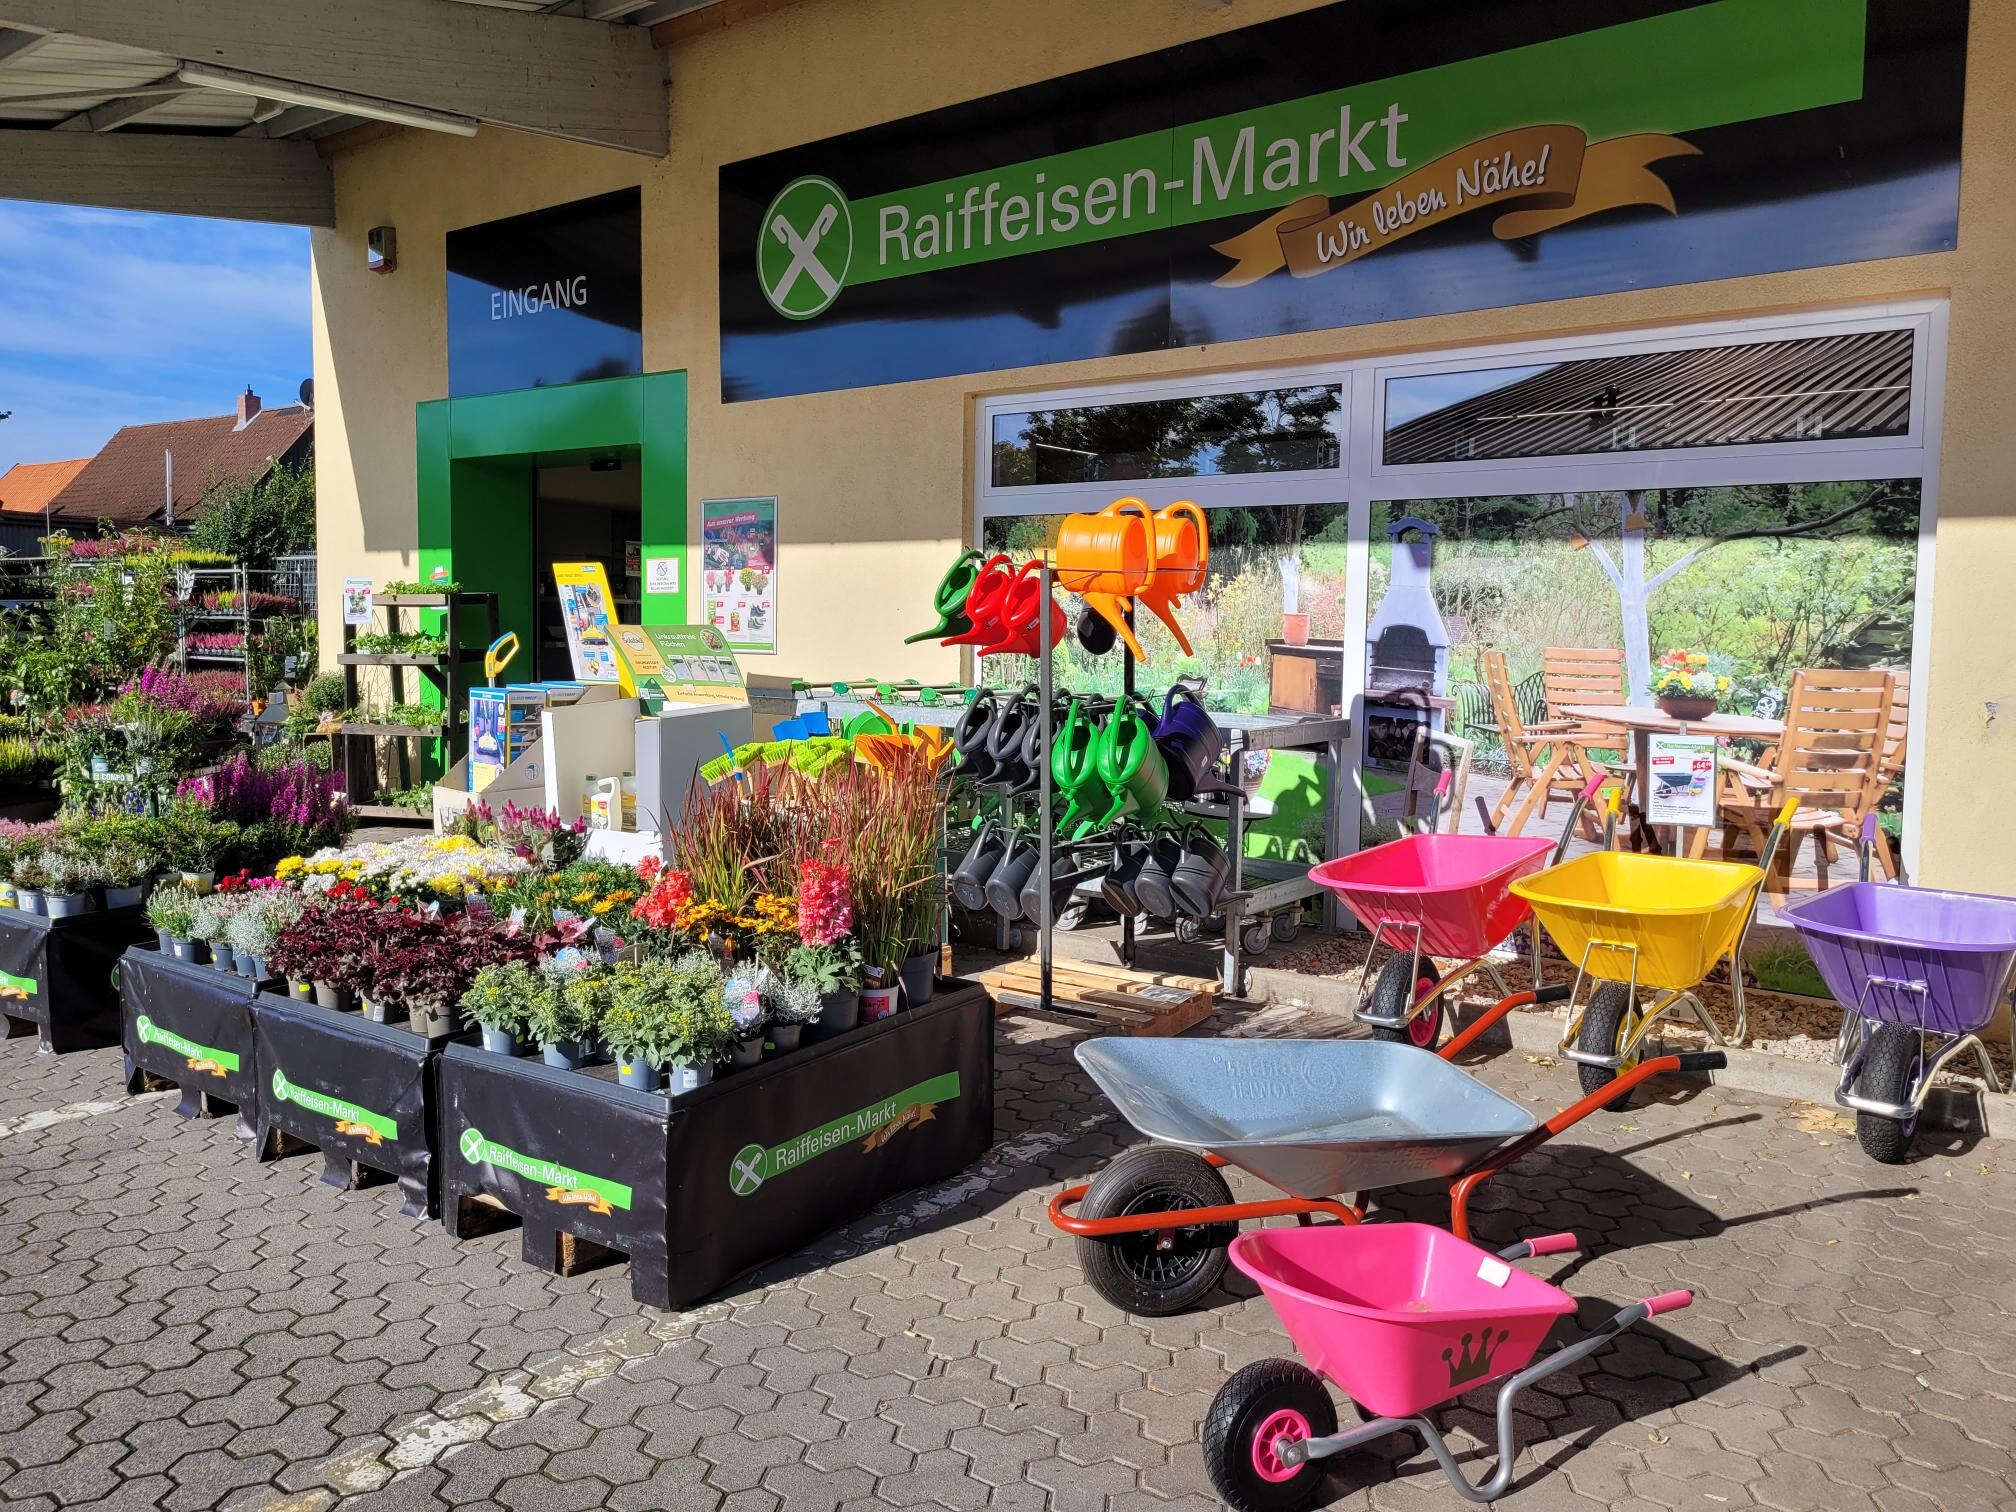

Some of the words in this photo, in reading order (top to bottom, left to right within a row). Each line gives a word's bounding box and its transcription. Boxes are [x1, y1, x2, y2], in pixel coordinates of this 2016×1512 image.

[879, 103, 1409, 265] Raiffeisen-Markt
[1316, 220, 1371, 264] Wir
[1371, 187, 1447, 235] leben
[1456, 143, 1551, 205] Nähe!
[491, 275, 588, 320] EINGANG
[101, 773, 125, 781] COMPO
[776, 1101, 897, 1169] Raiffeisen-Markt
[489, 1145, 578, 1189] Raiffeisen-Markt
